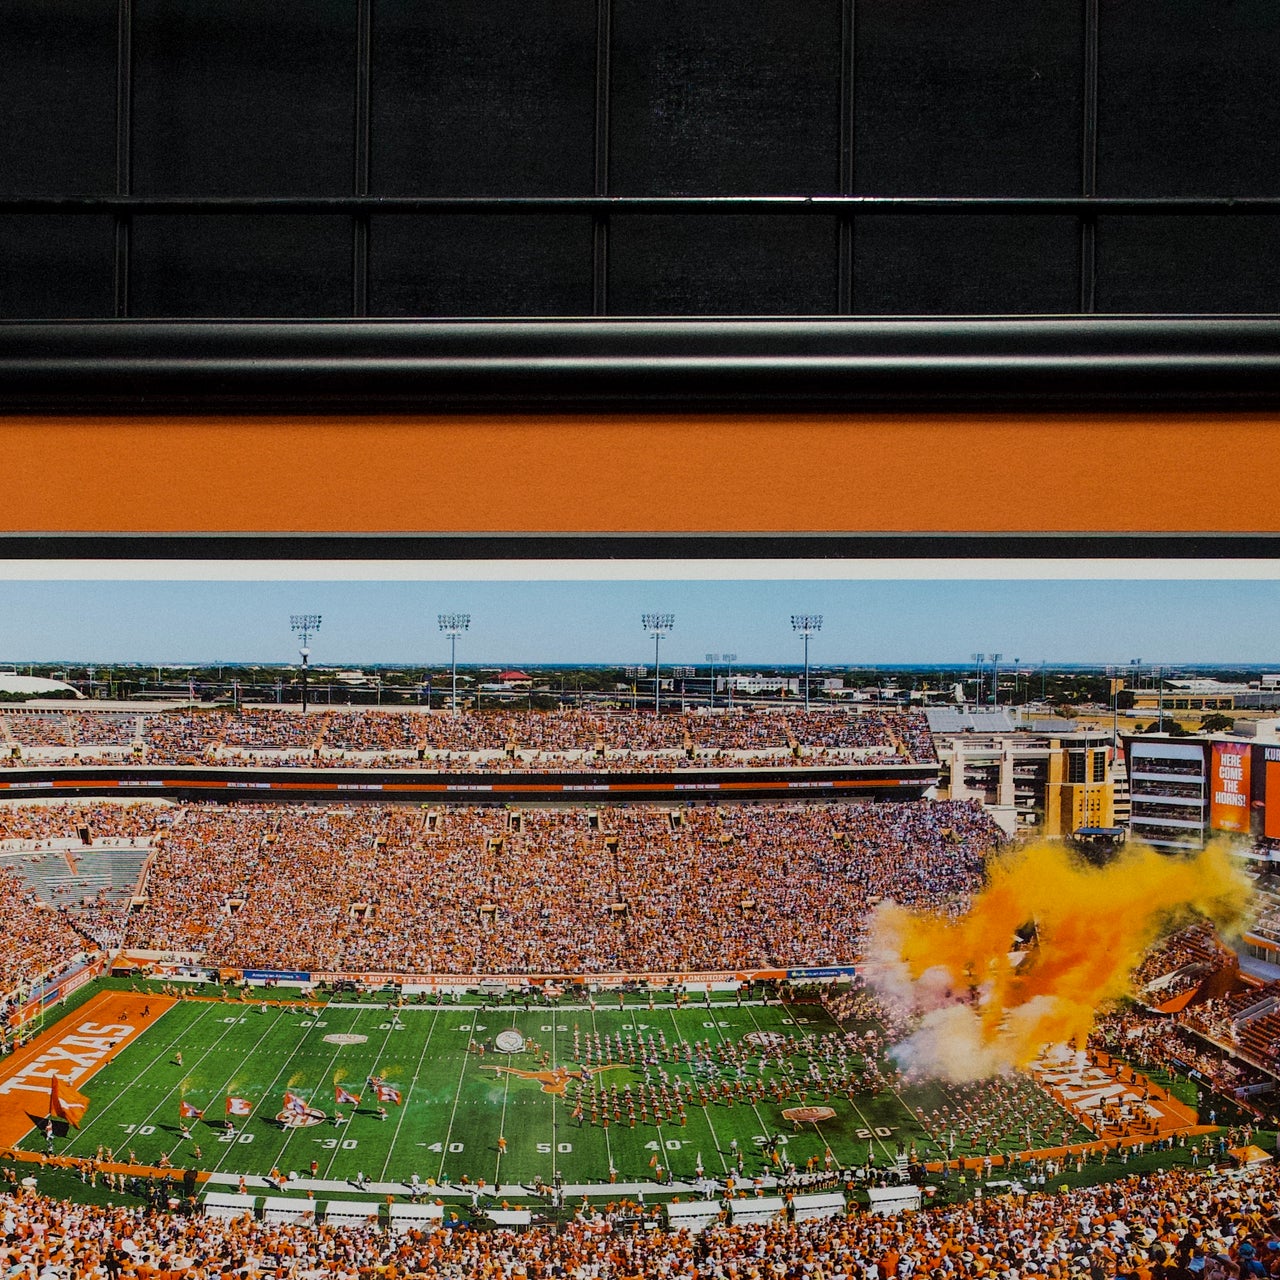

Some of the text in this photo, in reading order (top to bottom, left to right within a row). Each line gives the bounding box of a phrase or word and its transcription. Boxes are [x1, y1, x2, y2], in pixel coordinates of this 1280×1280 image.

[1221, 753, 1241, 767] HERE
[1219, 766, 1243, 780] COME
[1223, 779, 1239, 793] THE
[1215, 791, 1246, 807] HORNS!
[314, 974, 354, 982] DARRELL
[369, 975, 432, 984] ROYAL-TEXAS
[123, 1124, 156, 1135] 10
[855, 1127, 892, 1139] 20
[218, 1131, 255, 1144] 20
[321, 1138, 358, 1150] 30
[427, 1142, 464, 1153] 40
[536, 1142, 573, 1154] 50
[644, 1140, 681, 1151] 40
